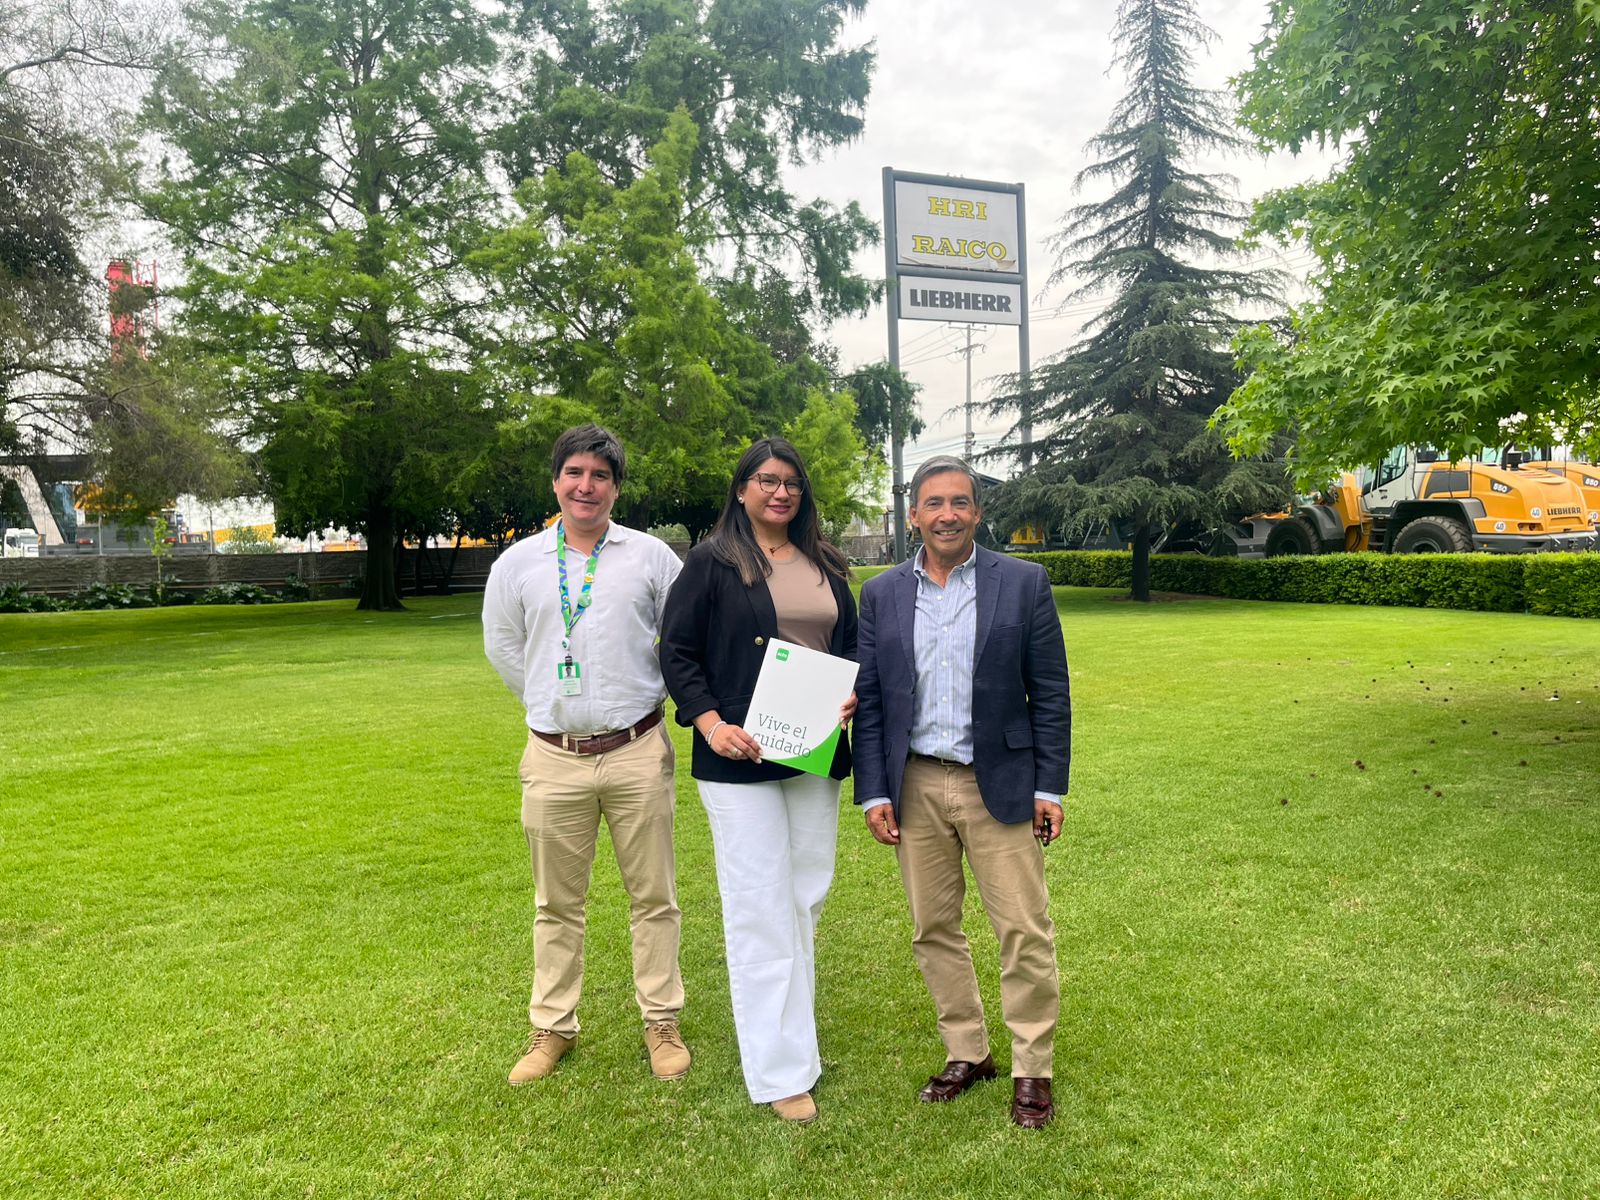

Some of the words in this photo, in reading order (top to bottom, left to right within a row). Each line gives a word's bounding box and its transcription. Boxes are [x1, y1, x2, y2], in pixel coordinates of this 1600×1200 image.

[928, 196, 987, 221] HRI
[912, 235, 1007, 260] RAICO
[909, 288, 1012, 313] LIEBHERR
[1546, 507, 1581, 516] LIEBHERR
[759, 713, 791, 735] Vive
[793, 726, 807, 740] el
[752, 732, 811, 758] cuidado
